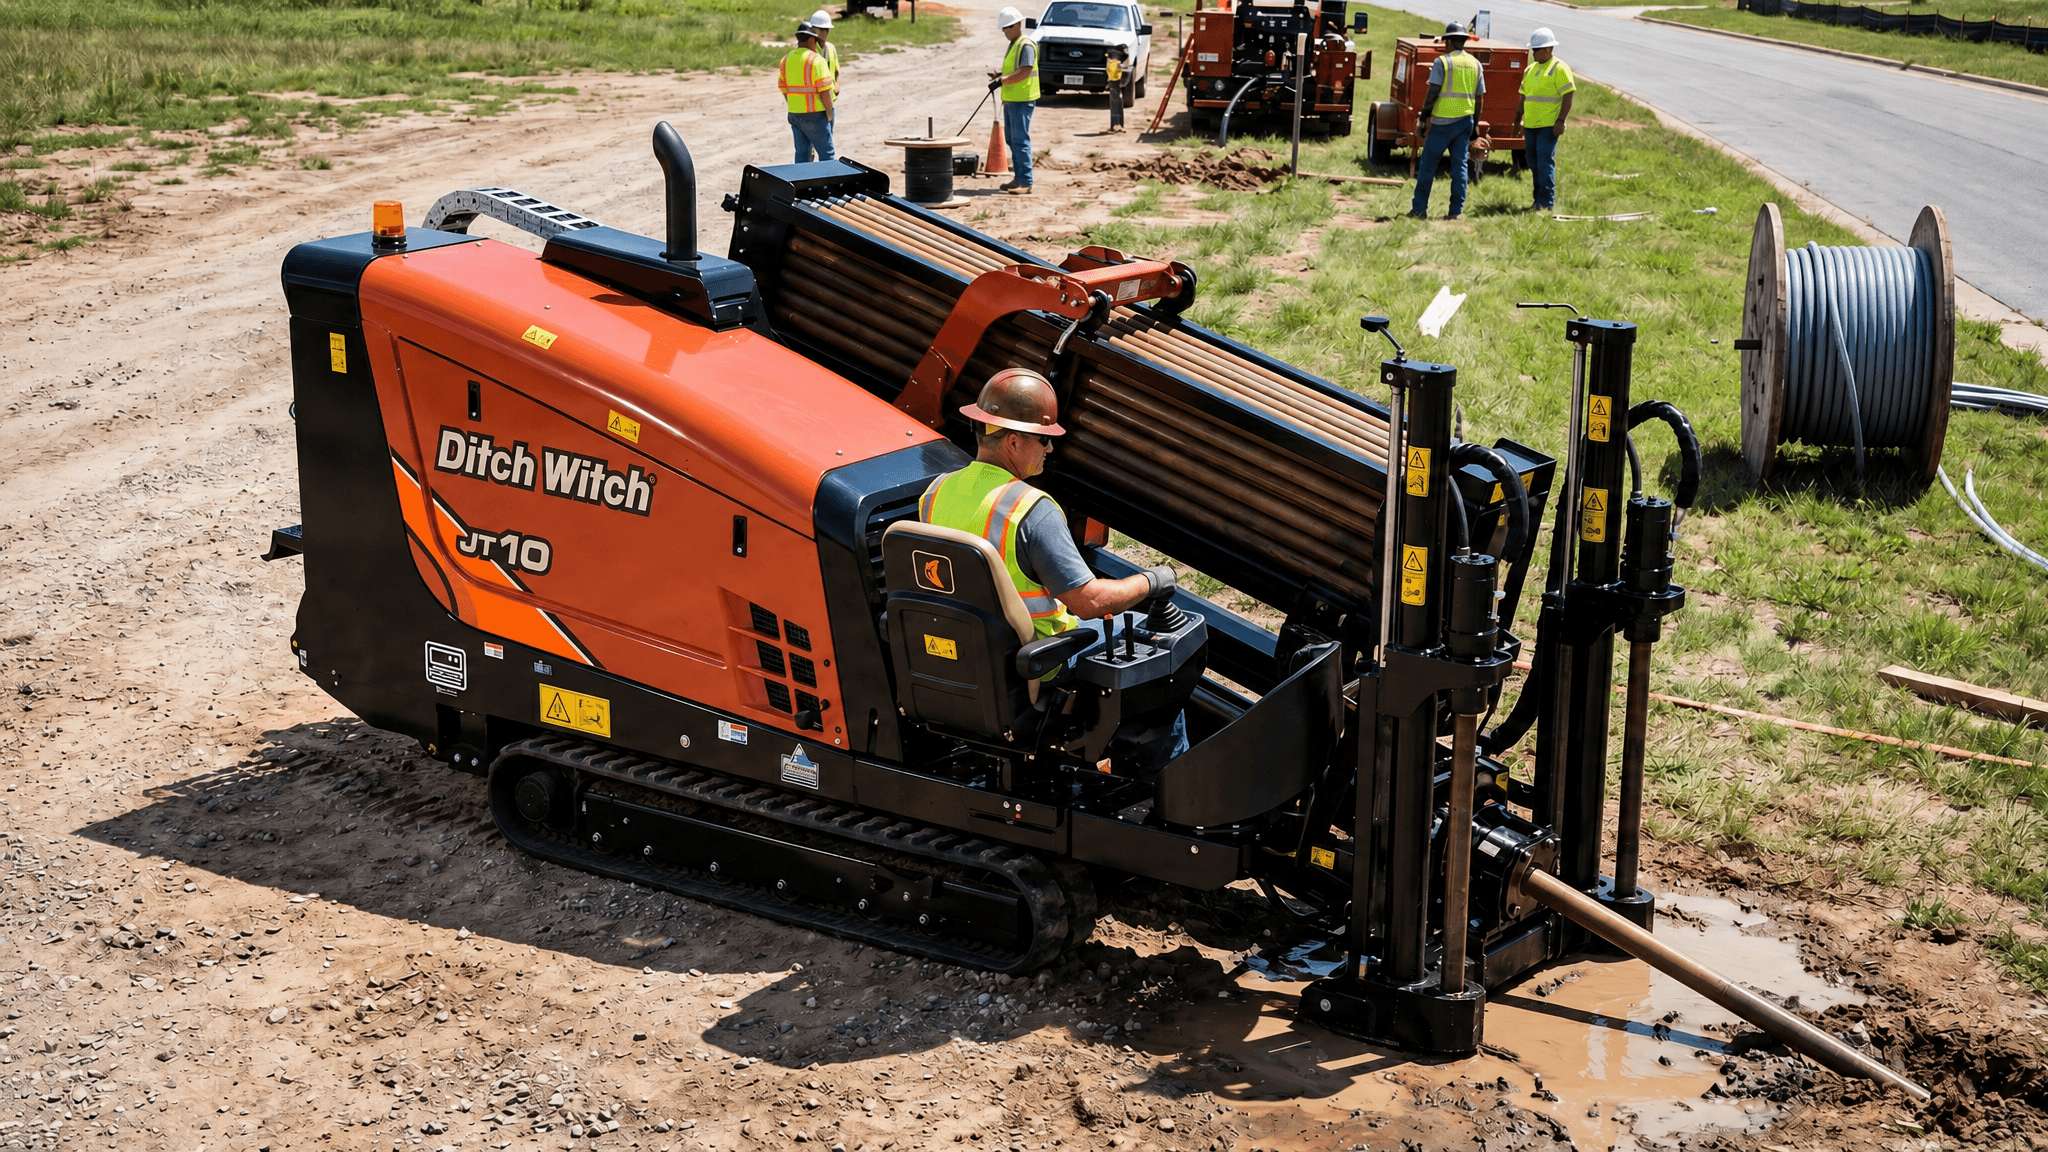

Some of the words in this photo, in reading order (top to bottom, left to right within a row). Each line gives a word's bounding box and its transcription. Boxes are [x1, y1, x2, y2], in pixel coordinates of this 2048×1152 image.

[437, 429, 534, 487] Ditch
[544, 450, 651, 512] Witch
[459, 531, 550, 573] JT10
